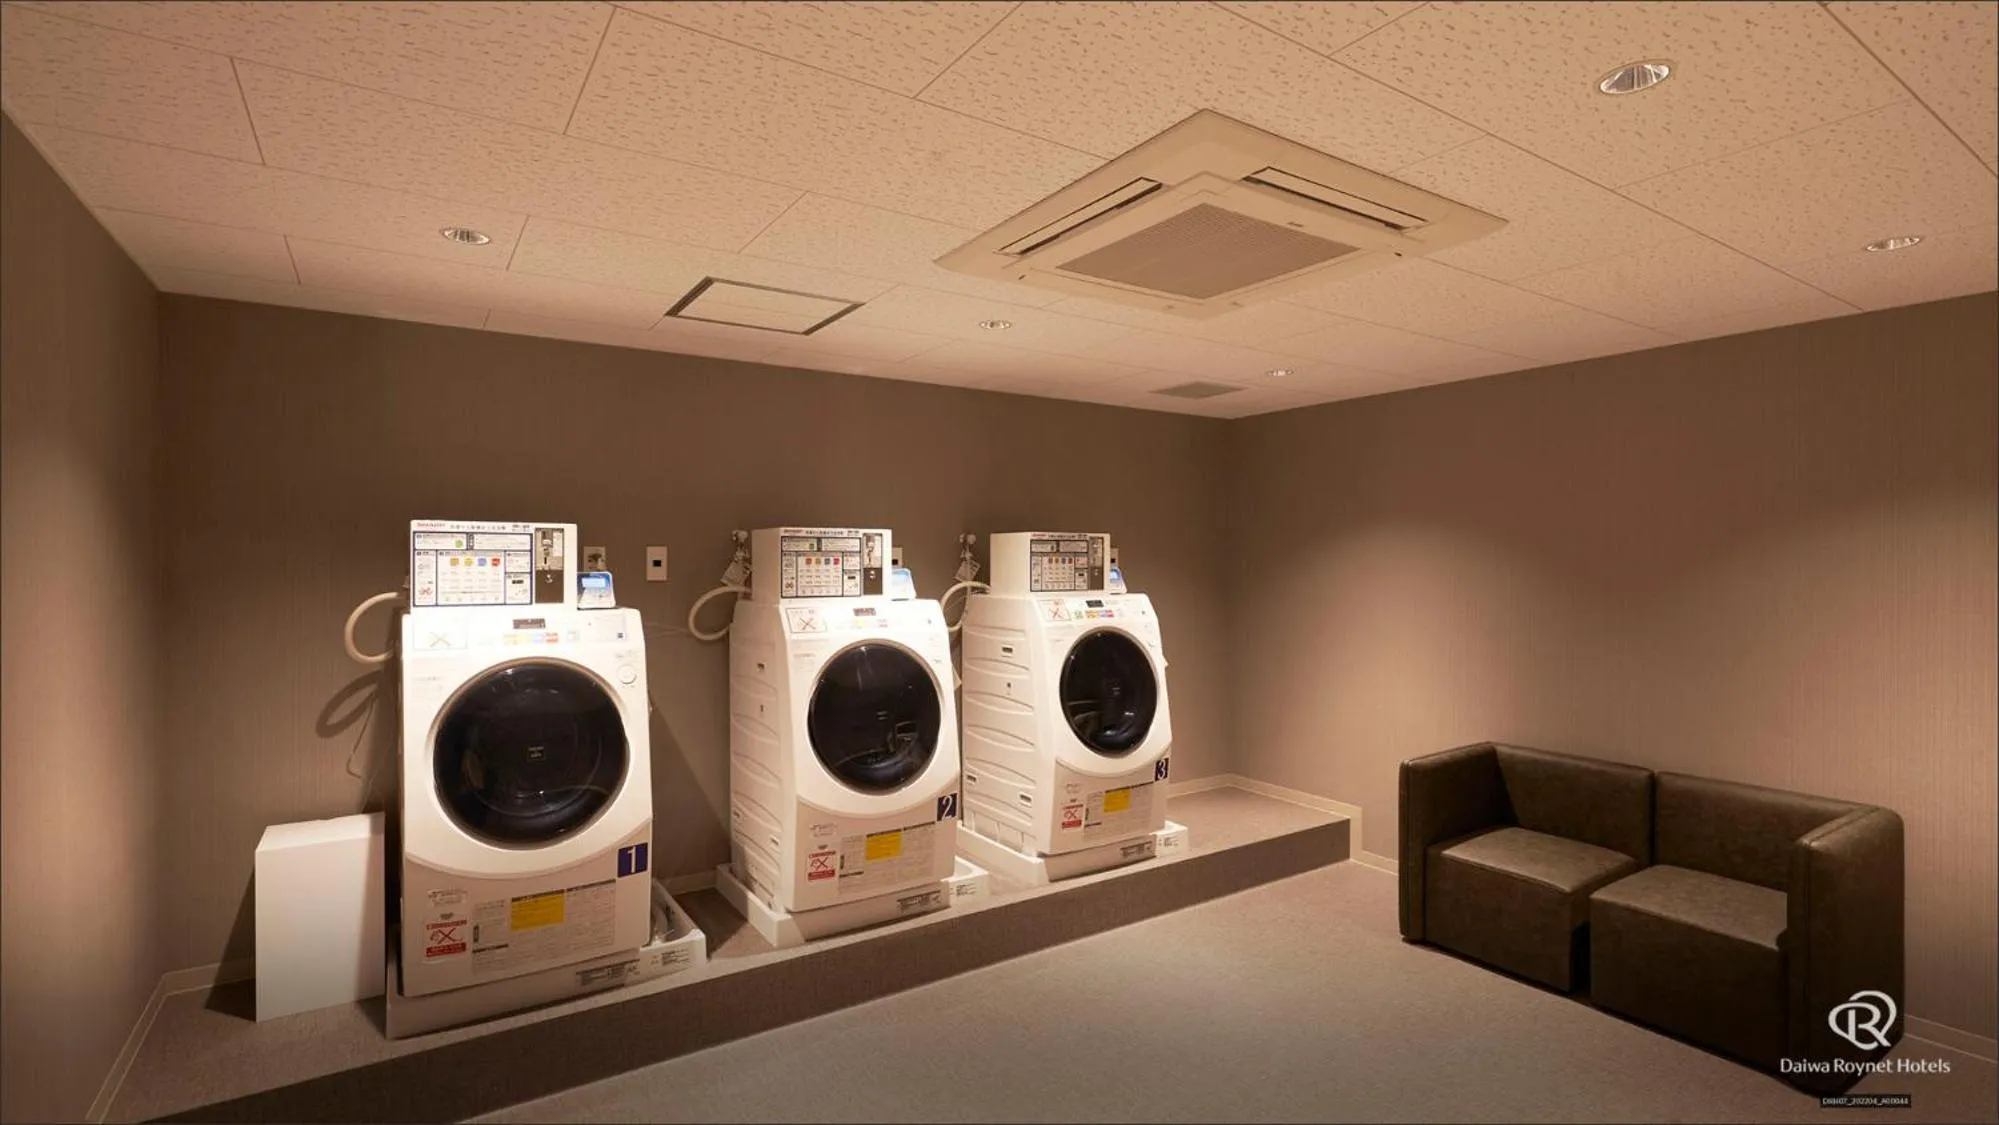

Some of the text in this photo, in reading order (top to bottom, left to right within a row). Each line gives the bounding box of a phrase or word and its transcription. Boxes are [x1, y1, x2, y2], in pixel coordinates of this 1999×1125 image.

[1157, 759, 1166, 780] 3
[941, 795, 953, 820] 2
[627, 844, 637, 874] 1
